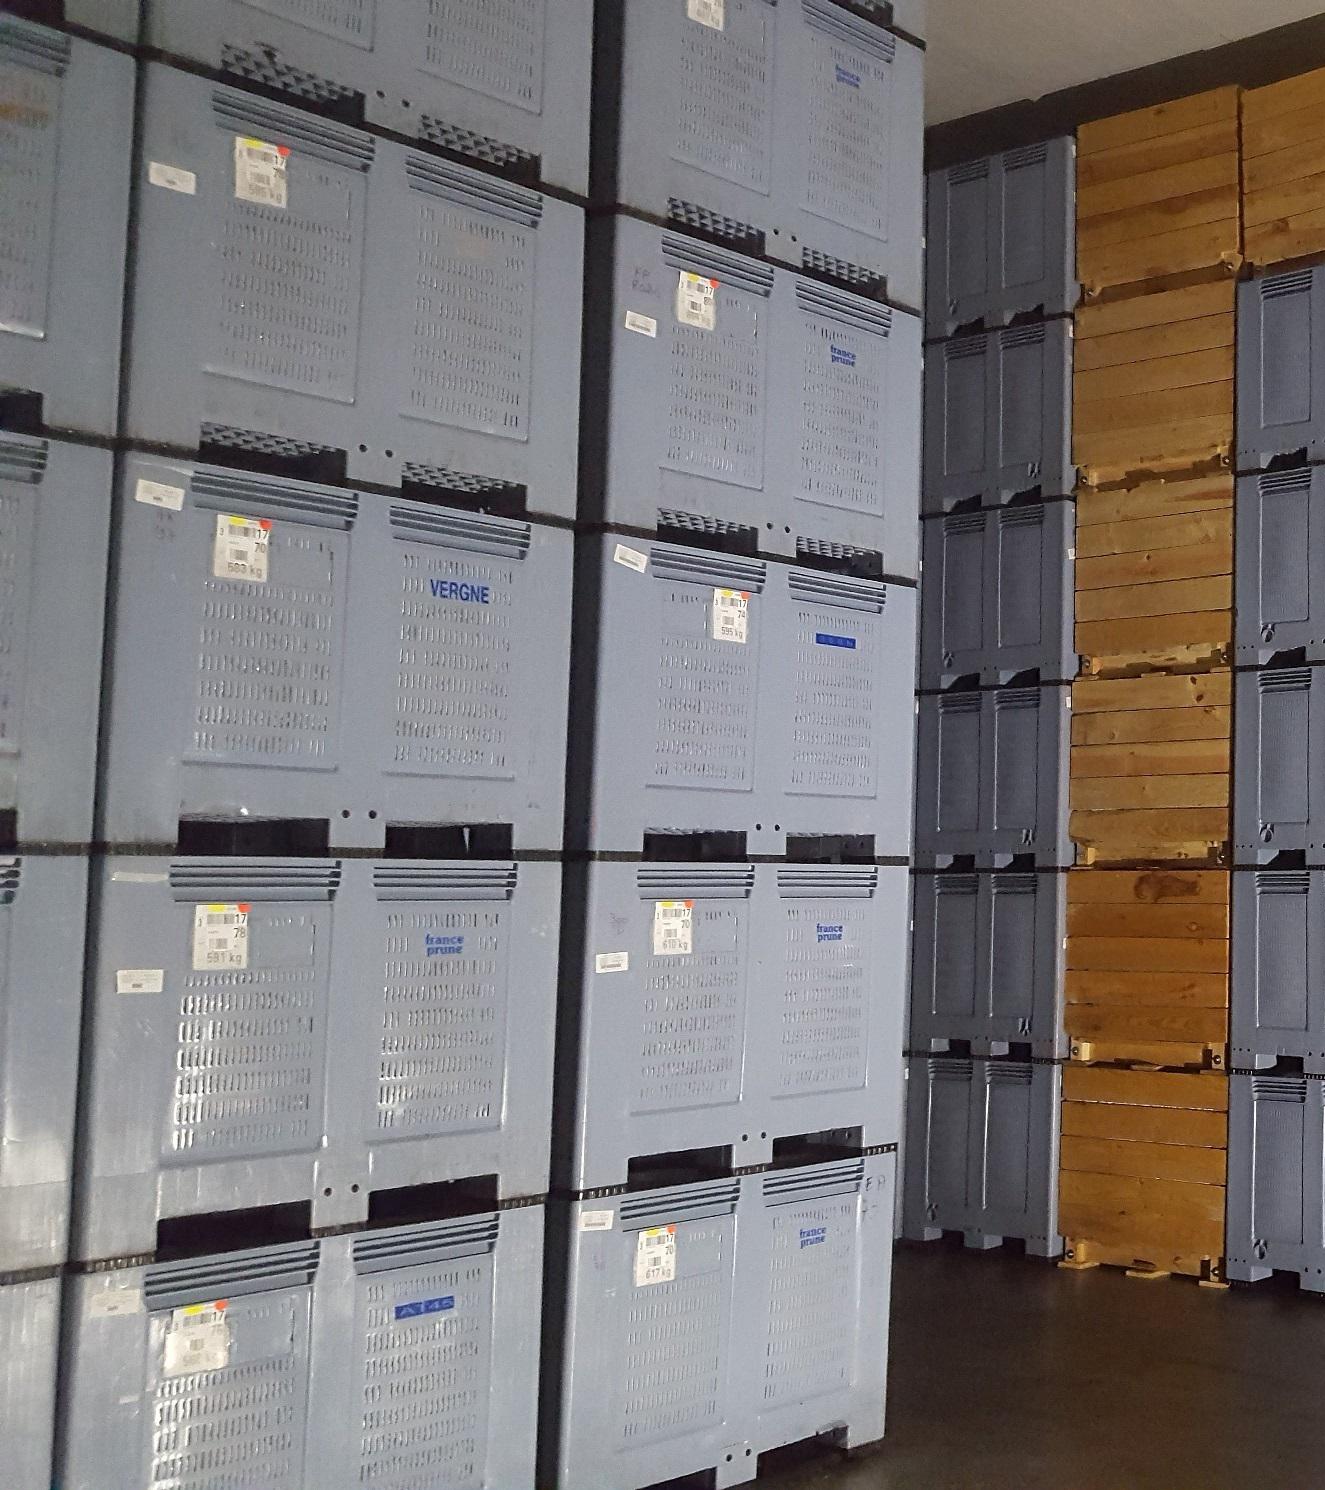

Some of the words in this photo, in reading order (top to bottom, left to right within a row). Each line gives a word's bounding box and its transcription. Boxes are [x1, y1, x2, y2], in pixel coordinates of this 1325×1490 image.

[256, 529, 269, 540] 17
[249, 564, 263, 580] kg
[430, 579, 489, 604] VERGNE
[739, 599, 748, 608] 17
[734, 628, 743, 640] kg
[235, 913, 247, 925] 17
[682, 908, 691, 918] 17
[816, 922, 843, 933] france
[425, 933, 464, 945] france
[817, 933, 843, 943] prune
[427, 945, 463, 957] prune
[678, 941, 689, 952] kg
[229, 952, 243, 966] kg
